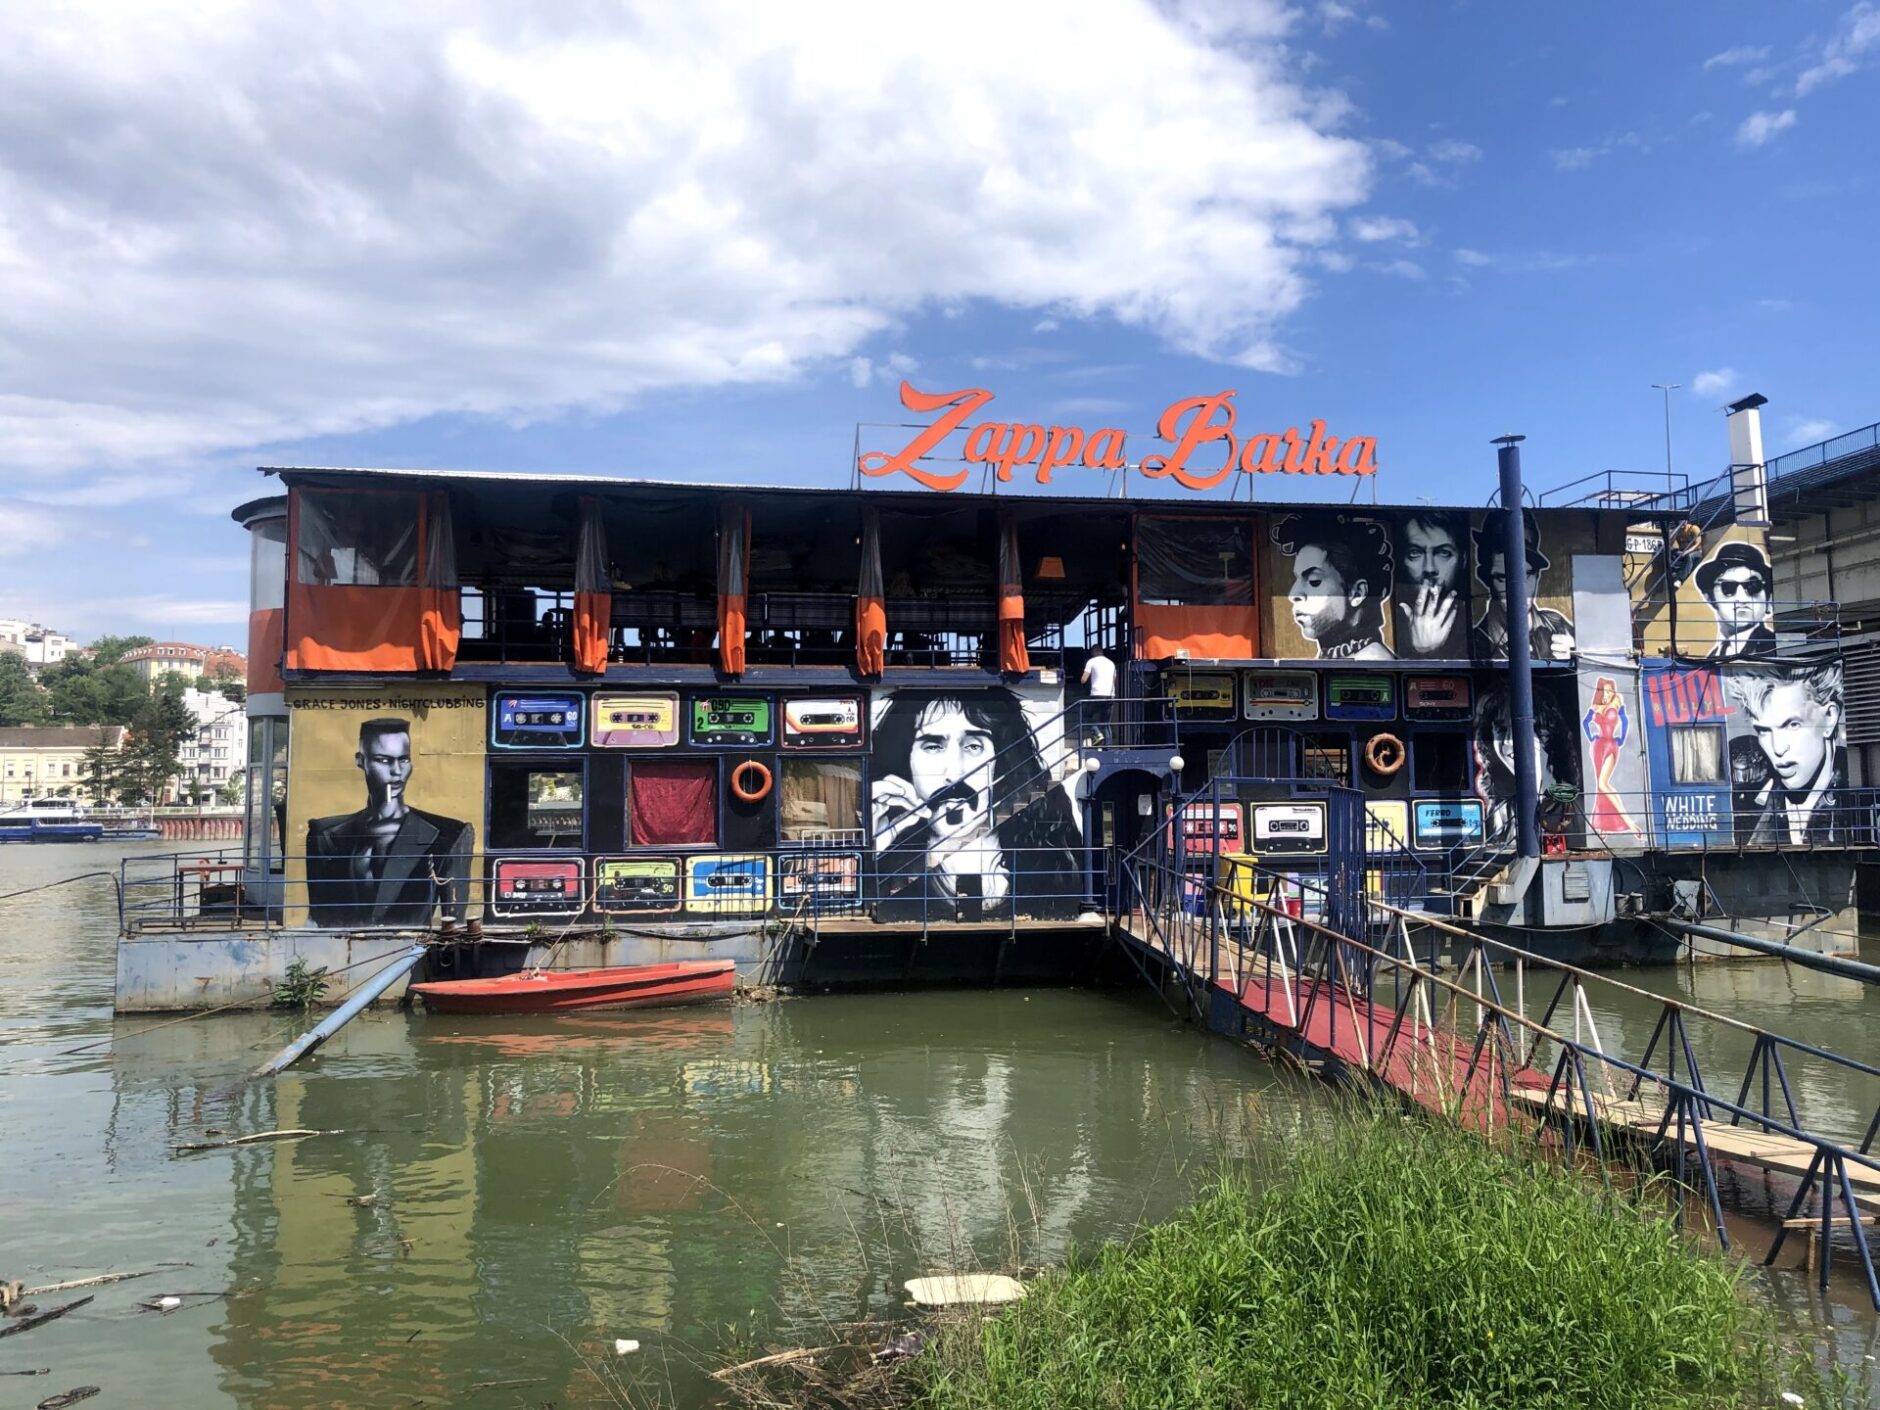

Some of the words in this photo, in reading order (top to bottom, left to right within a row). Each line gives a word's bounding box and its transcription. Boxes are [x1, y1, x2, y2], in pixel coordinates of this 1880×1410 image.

[859, 379, 1127, 492] Zappa
[1140, 389, 1380, 491] Barka
[293, 699, 335, 710] GRACE
[340, 699, 382, 710] JONES
[1647, 668, 1737, 728] IDOL
[504, 713, 512, 723] A
[697, 716, 705, 730] 2
[1661, 795, 1718, 818] WHITE
[662, 883, 675, 894] 90
